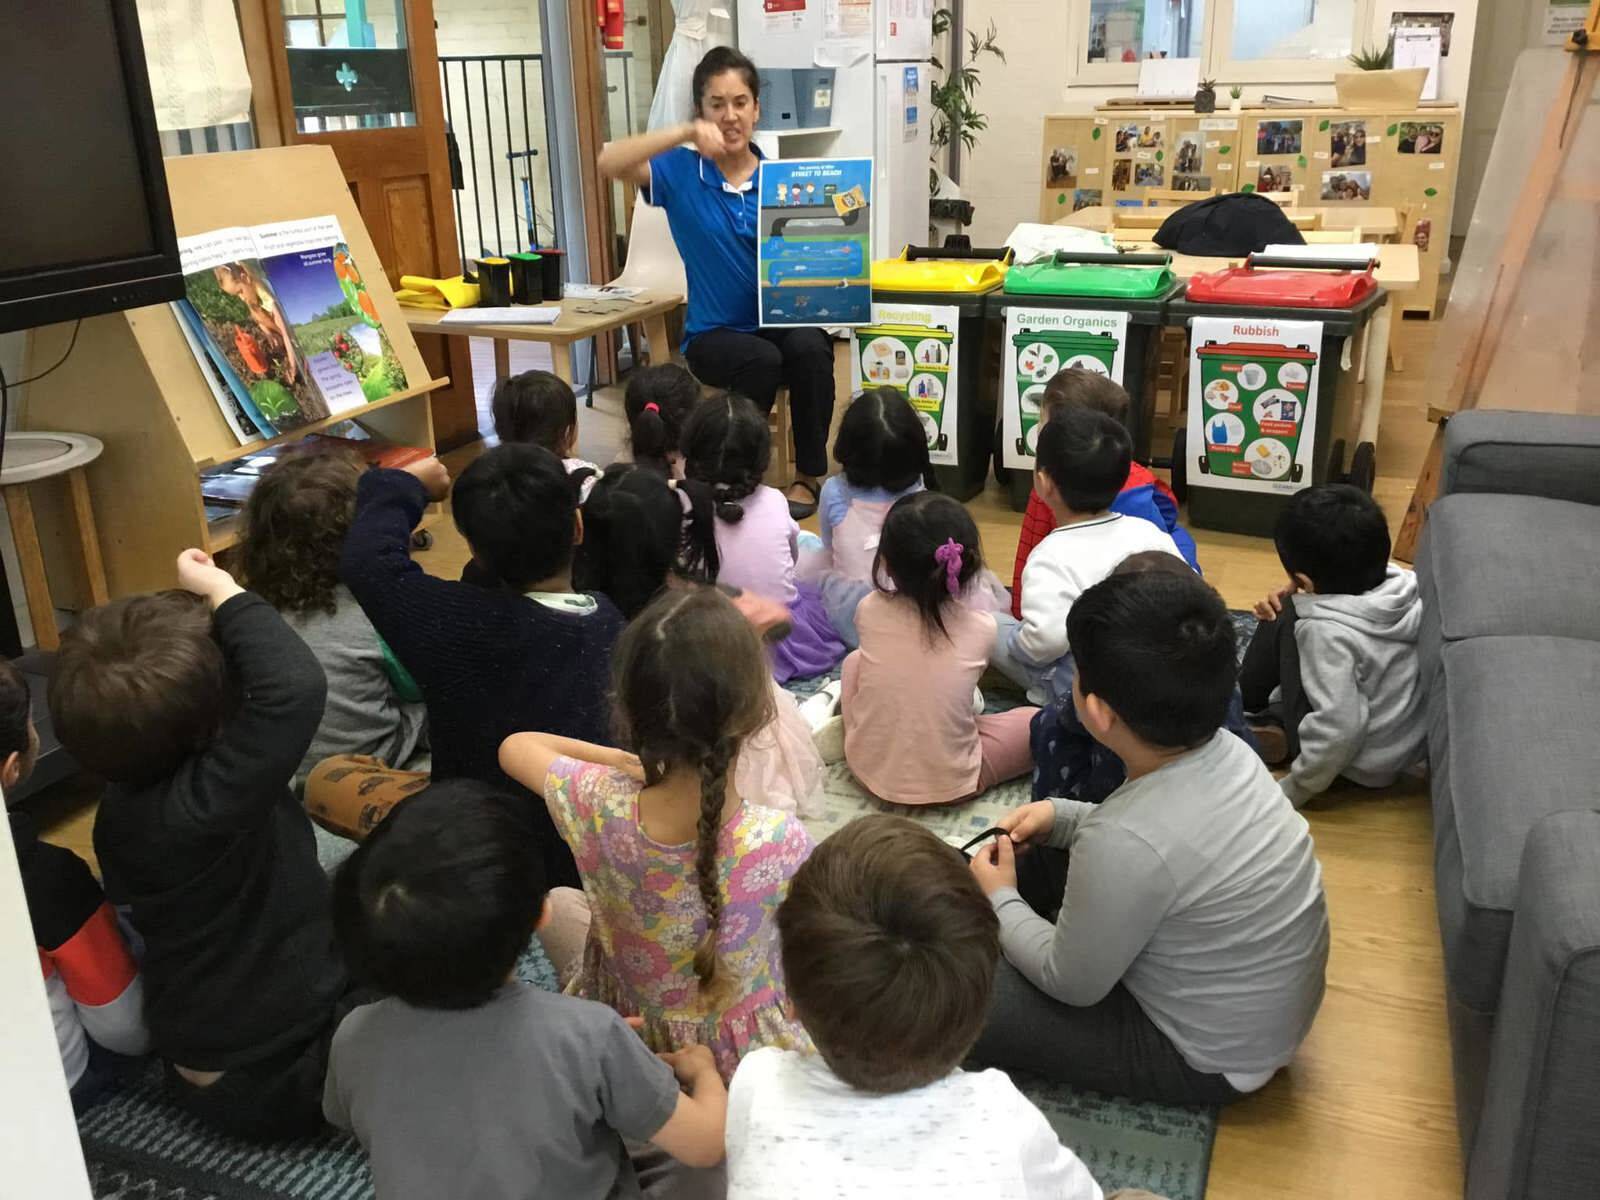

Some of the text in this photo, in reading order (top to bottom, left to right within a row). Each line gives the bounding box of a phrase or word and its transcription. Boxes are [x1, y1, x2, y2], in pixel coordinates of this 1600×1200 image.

[791, 170, 812, 178] STREET
[879, 309, 932, 323] Recycling
[1016, 313, 1118, 328] Garden Organics
[1233, 324, 1280, 337] Rubbish
